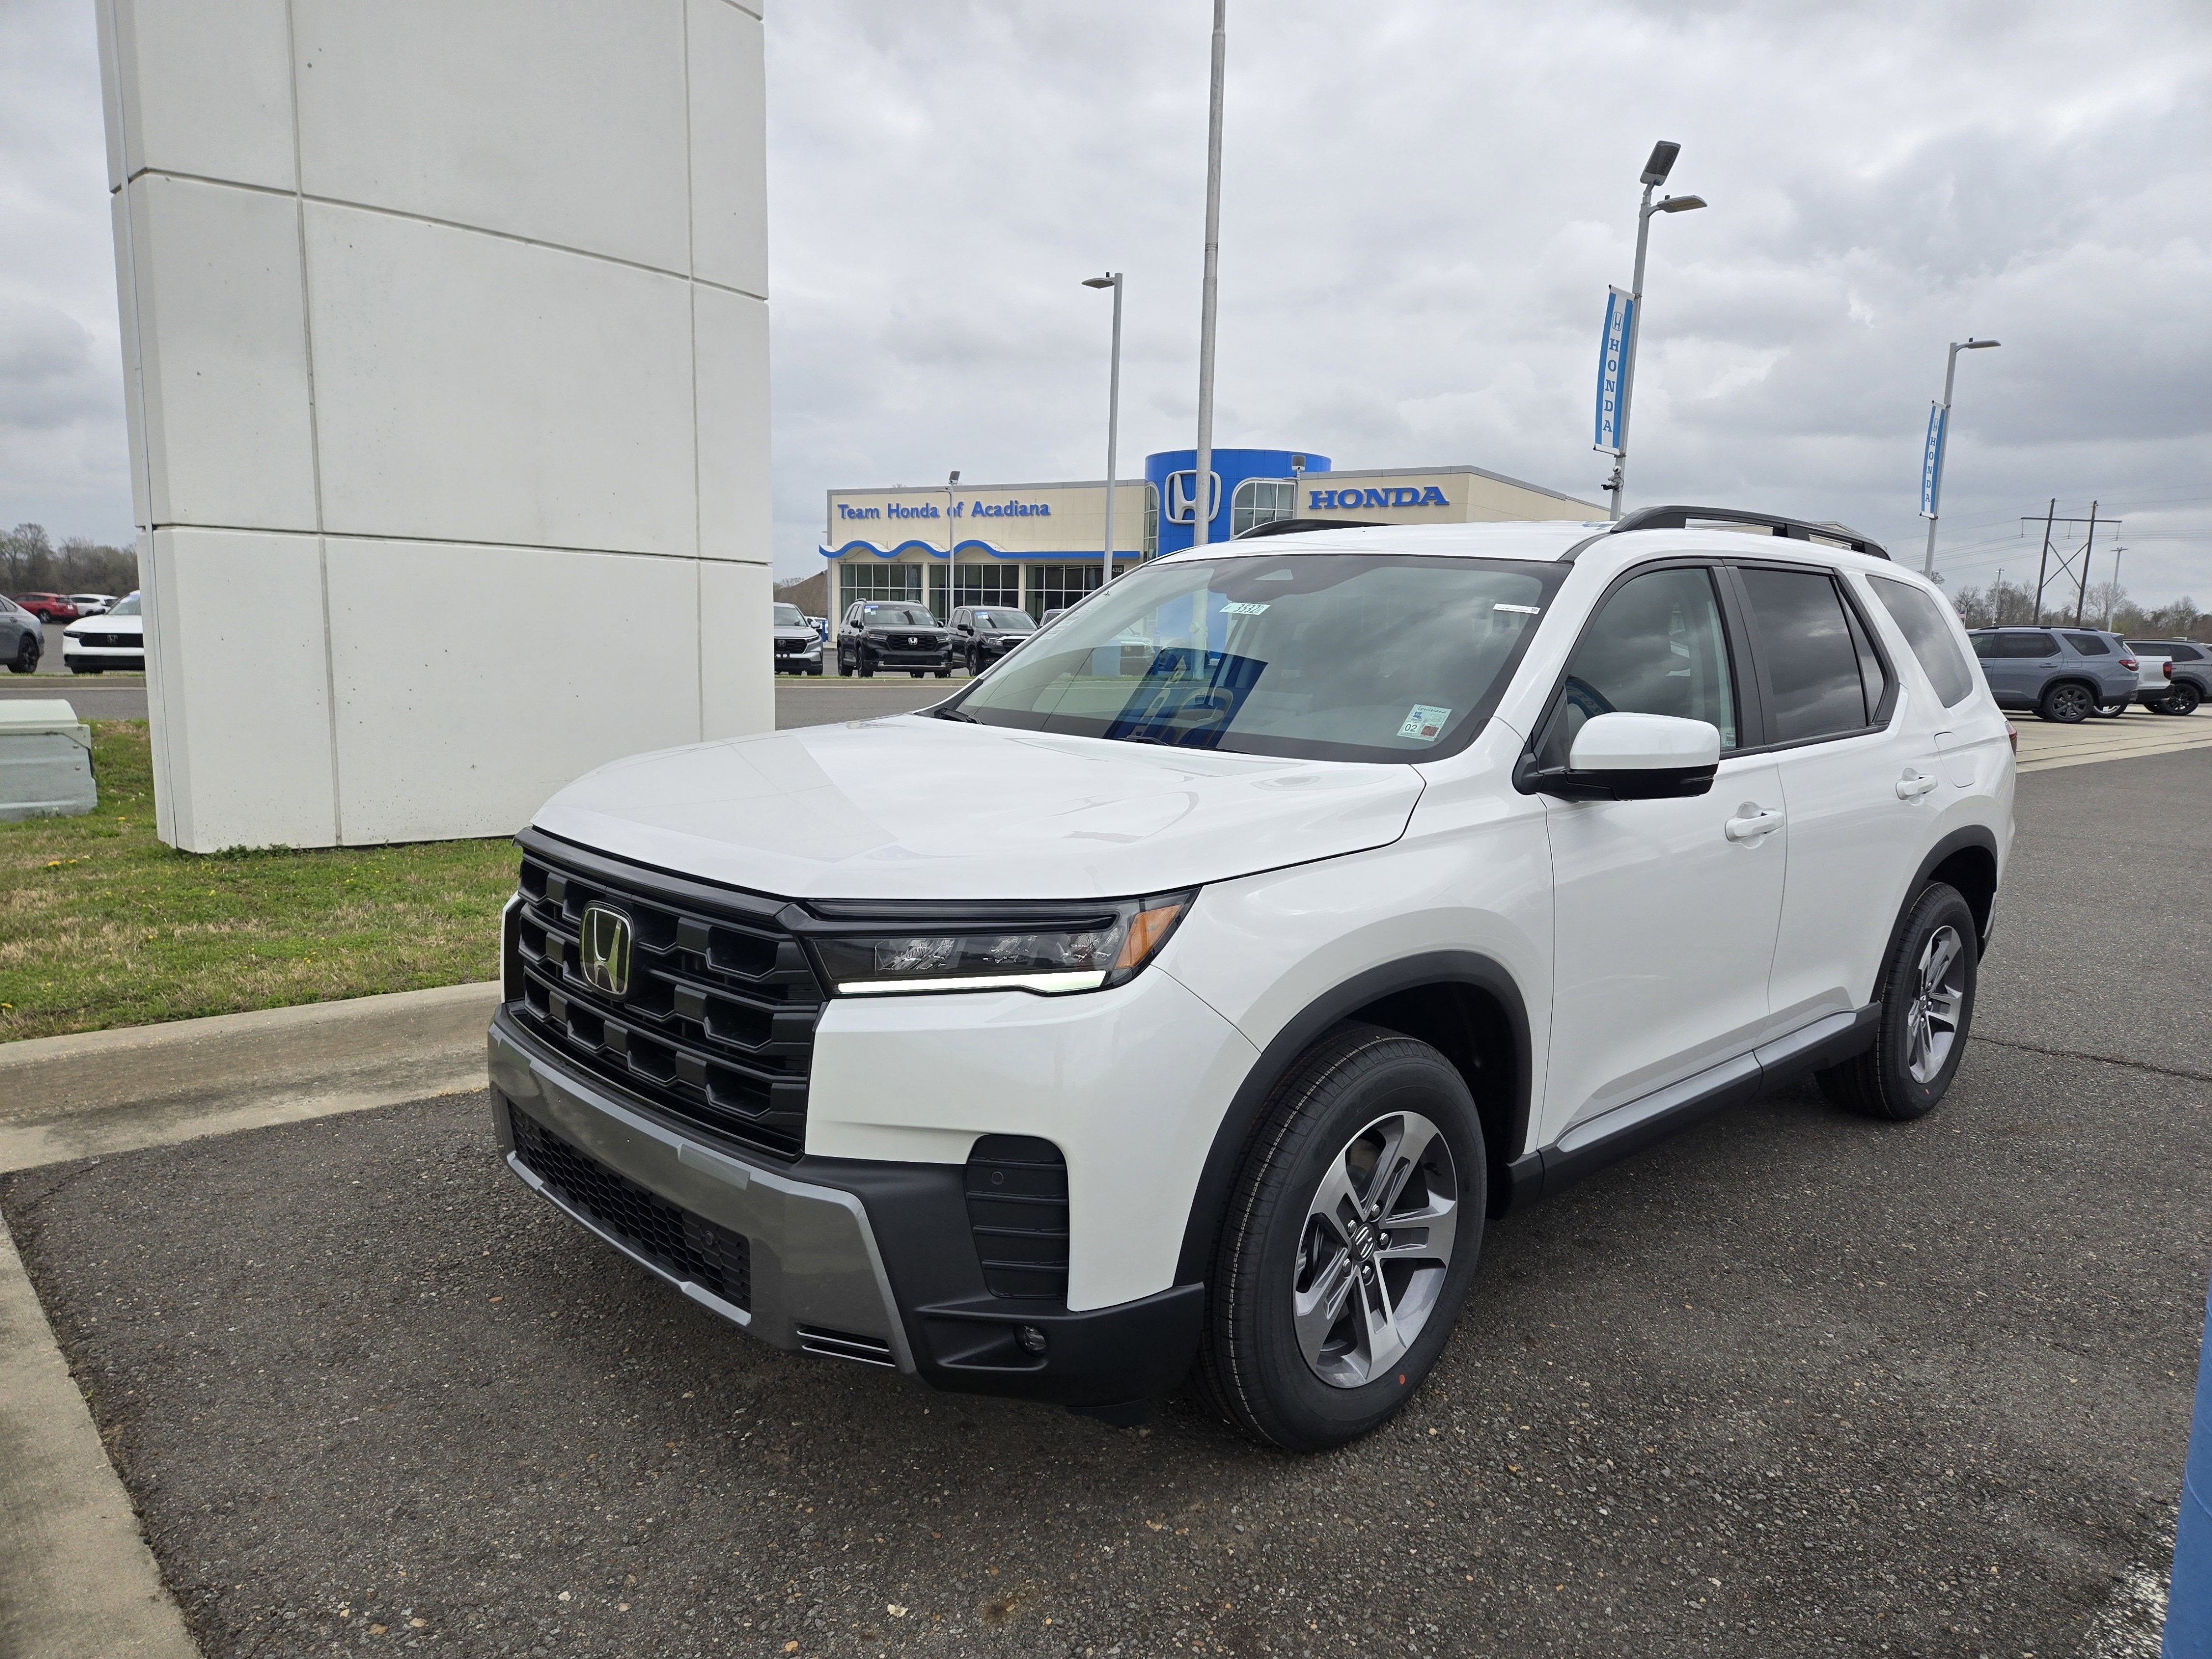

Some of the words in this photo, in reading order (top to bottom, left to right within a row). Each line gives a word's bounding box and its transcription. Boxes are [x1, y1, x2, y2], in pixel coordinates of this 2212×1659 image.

[1603, 338, 1620, 432] HONDA
[1925, 437, 1937, 502] HONDA
[1308, 486, 1450, 509] HONDA
[837, 504, 880, 519] Team
[888, 502, 940, 519] Honda
[947, 501, 964, 518] of
[971, 500, 1051, 517] Acadiana
[1233, 603, 1261, 613] 3532
[1405, 723, 1418, 732] 02
